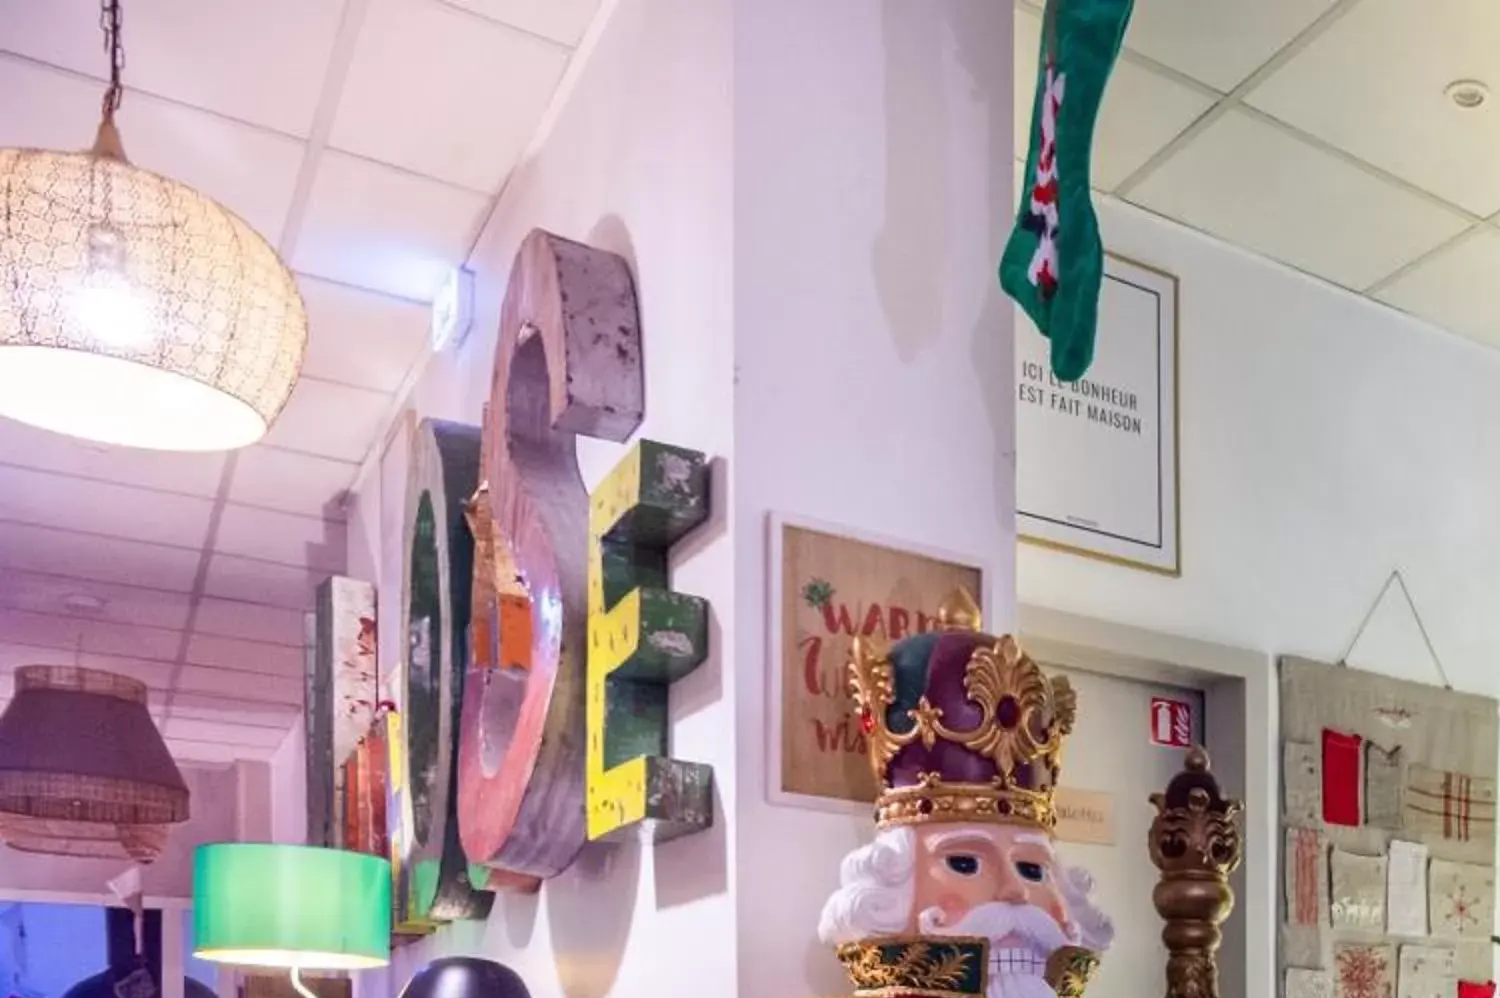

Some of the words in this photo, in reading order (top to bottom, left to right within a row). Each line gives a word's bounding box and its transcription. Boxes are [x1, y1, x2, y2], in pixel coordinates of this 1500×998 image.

[1018, 383, 1044, 405] EST
[1050, 393, 1080, 417] FAIT
[1087, 403, 1142, 434] MAISON
[1022, 360, 1043, 382] ICI
[1071, 379, 1138, 410] BONHEUR
